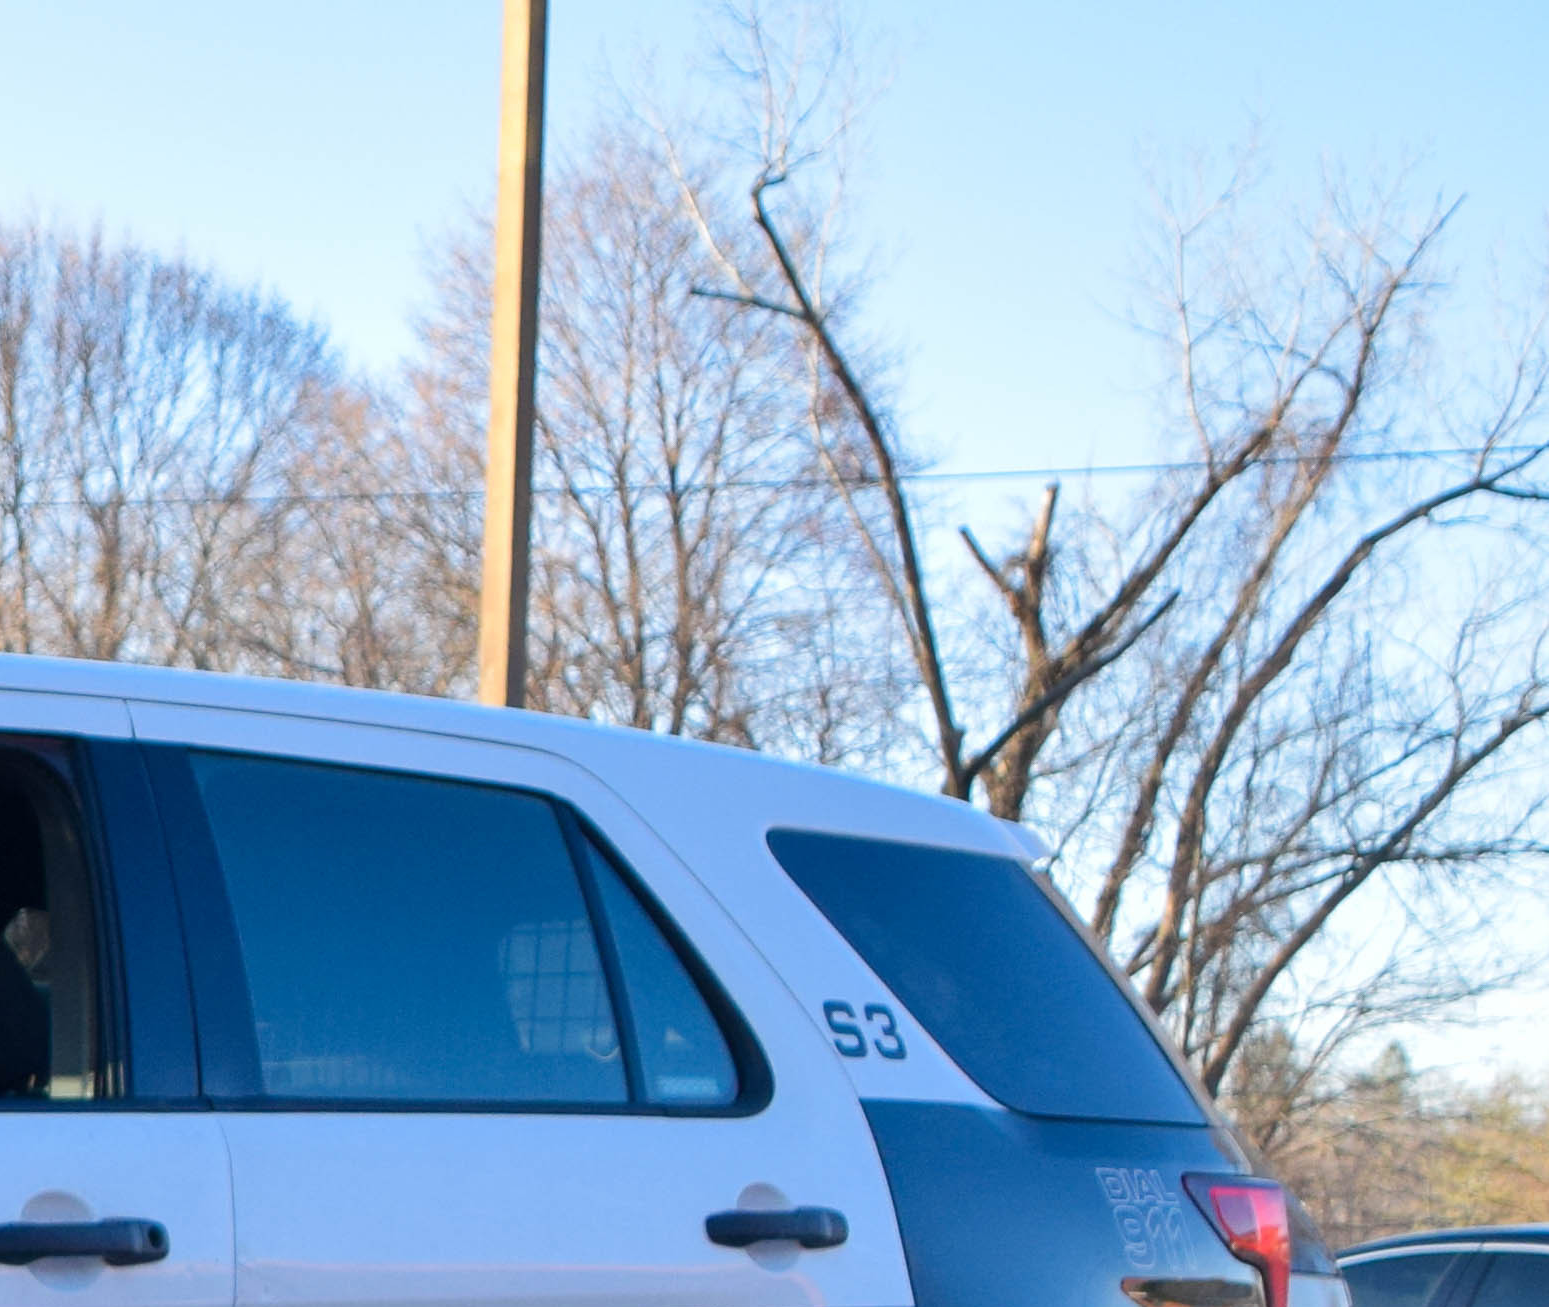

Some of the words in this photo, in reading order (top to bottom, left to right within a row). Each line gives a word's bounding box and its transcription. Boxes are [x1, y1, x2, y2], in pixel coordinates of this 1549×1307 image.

[822, 999, 907, 1060] S3
[1095, 1167, 1180, 1204] DIAL
[1113, 1204, 1197, 1271] 911
